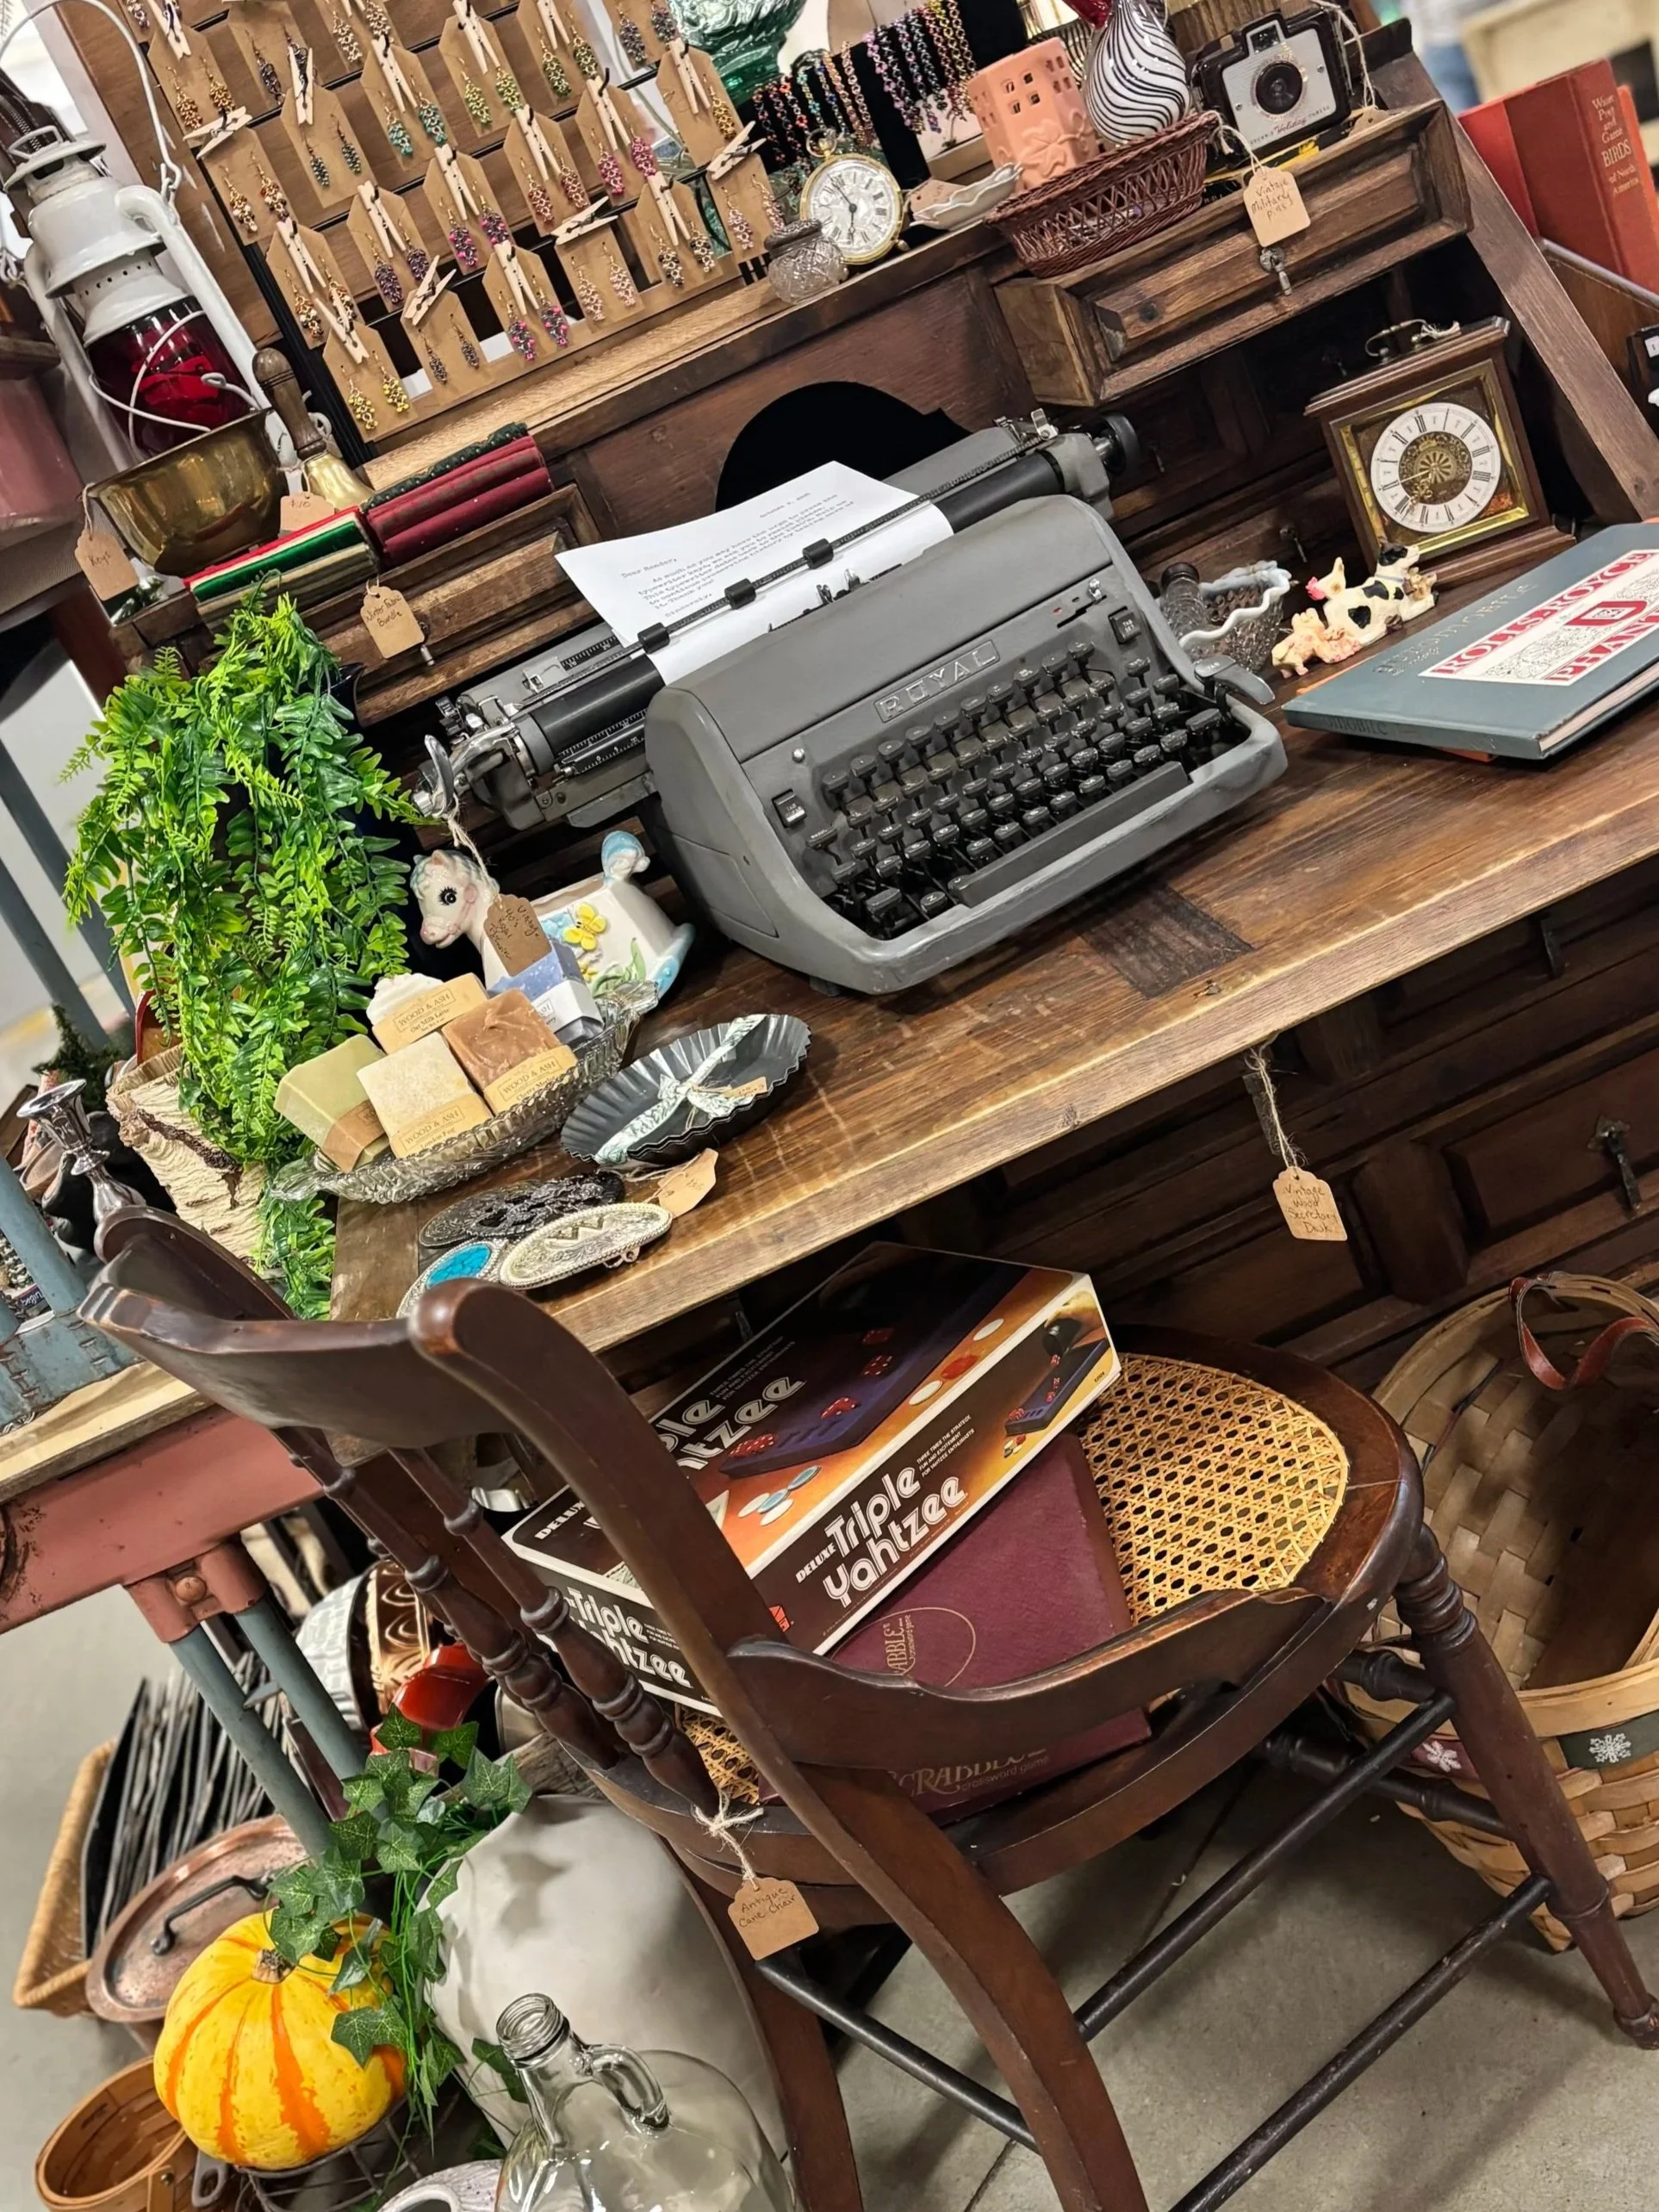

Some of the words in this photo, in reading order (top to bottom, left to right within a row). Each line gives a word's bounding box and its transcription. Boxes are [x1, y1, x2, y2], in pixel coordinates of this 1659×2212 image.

[1601, 139, 1632, 167] BIRDS
[88, 551, 111, 566] Keys
[1430, 553, 1656, 675] ROLLS-ROYCE
[879, 649, 997, 719] ROYAL
[398, 1007, 425, 1026] WOOD
[433, 993, 450, 1006] ASH
[503, 1074, 530, 1094] WOOD
[539, 1060, 556, 1073] ASH
[405, 1125, 432, 1144] WOOD
[442, 1109, 459, 1122] ASH
[919, 1461, 929, 1471] FUN
[928, 1453, 937, 1463] AND
[534, 1501, 586, 1540] DELUX
[795, 1542, 837, 1583] DELUXE
[823, 1466, 922, 1558] Triple
[822, 1476, 967, 1608] Yahtzee
[567, 1587, 649, 1644] Triple
[738, 1911, 766, 1928] Cane
[768, 1894, 796, 1914] Chair
[742, 1888, 788, 1913] Antique
